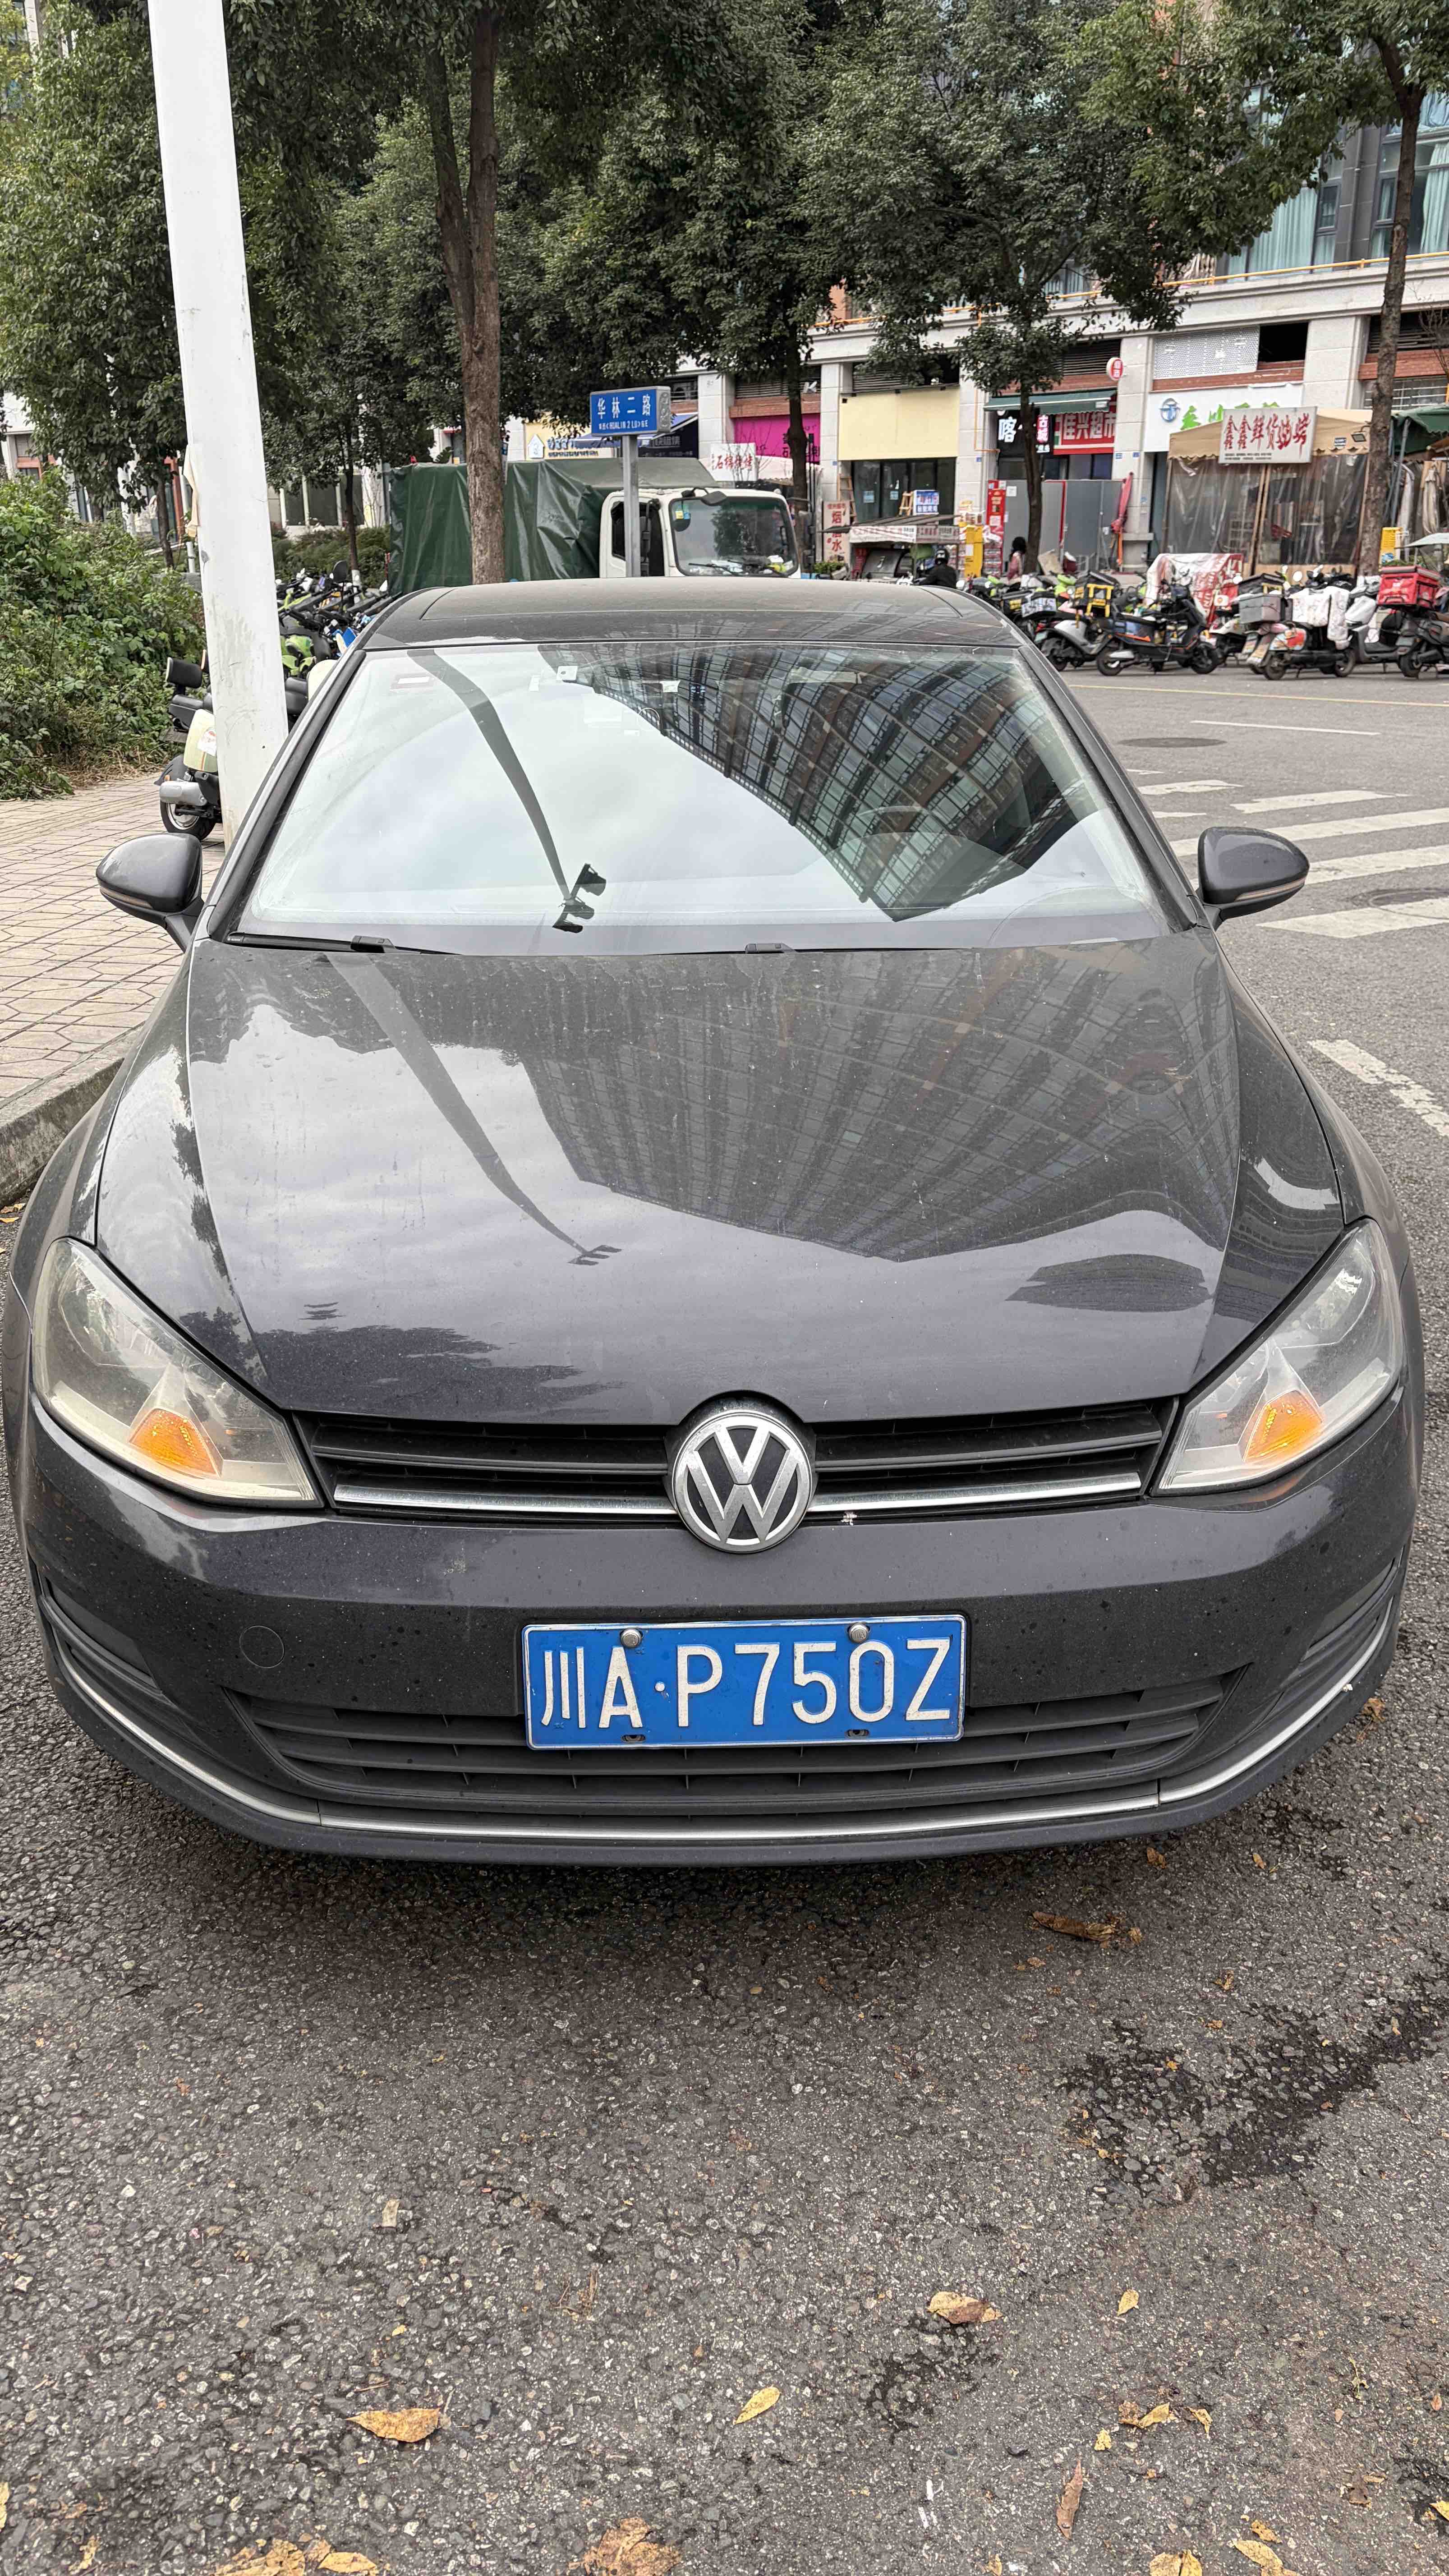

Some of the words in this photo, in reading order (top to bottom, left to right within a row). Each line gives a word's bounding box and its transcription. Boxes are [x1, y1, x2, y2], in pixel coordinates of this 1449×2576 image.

[597, 394, 651, 419] 华林二路
[998, 416, 1024, 443] 喀
[541, 1638, 952, 1729] 川A·P750Z
